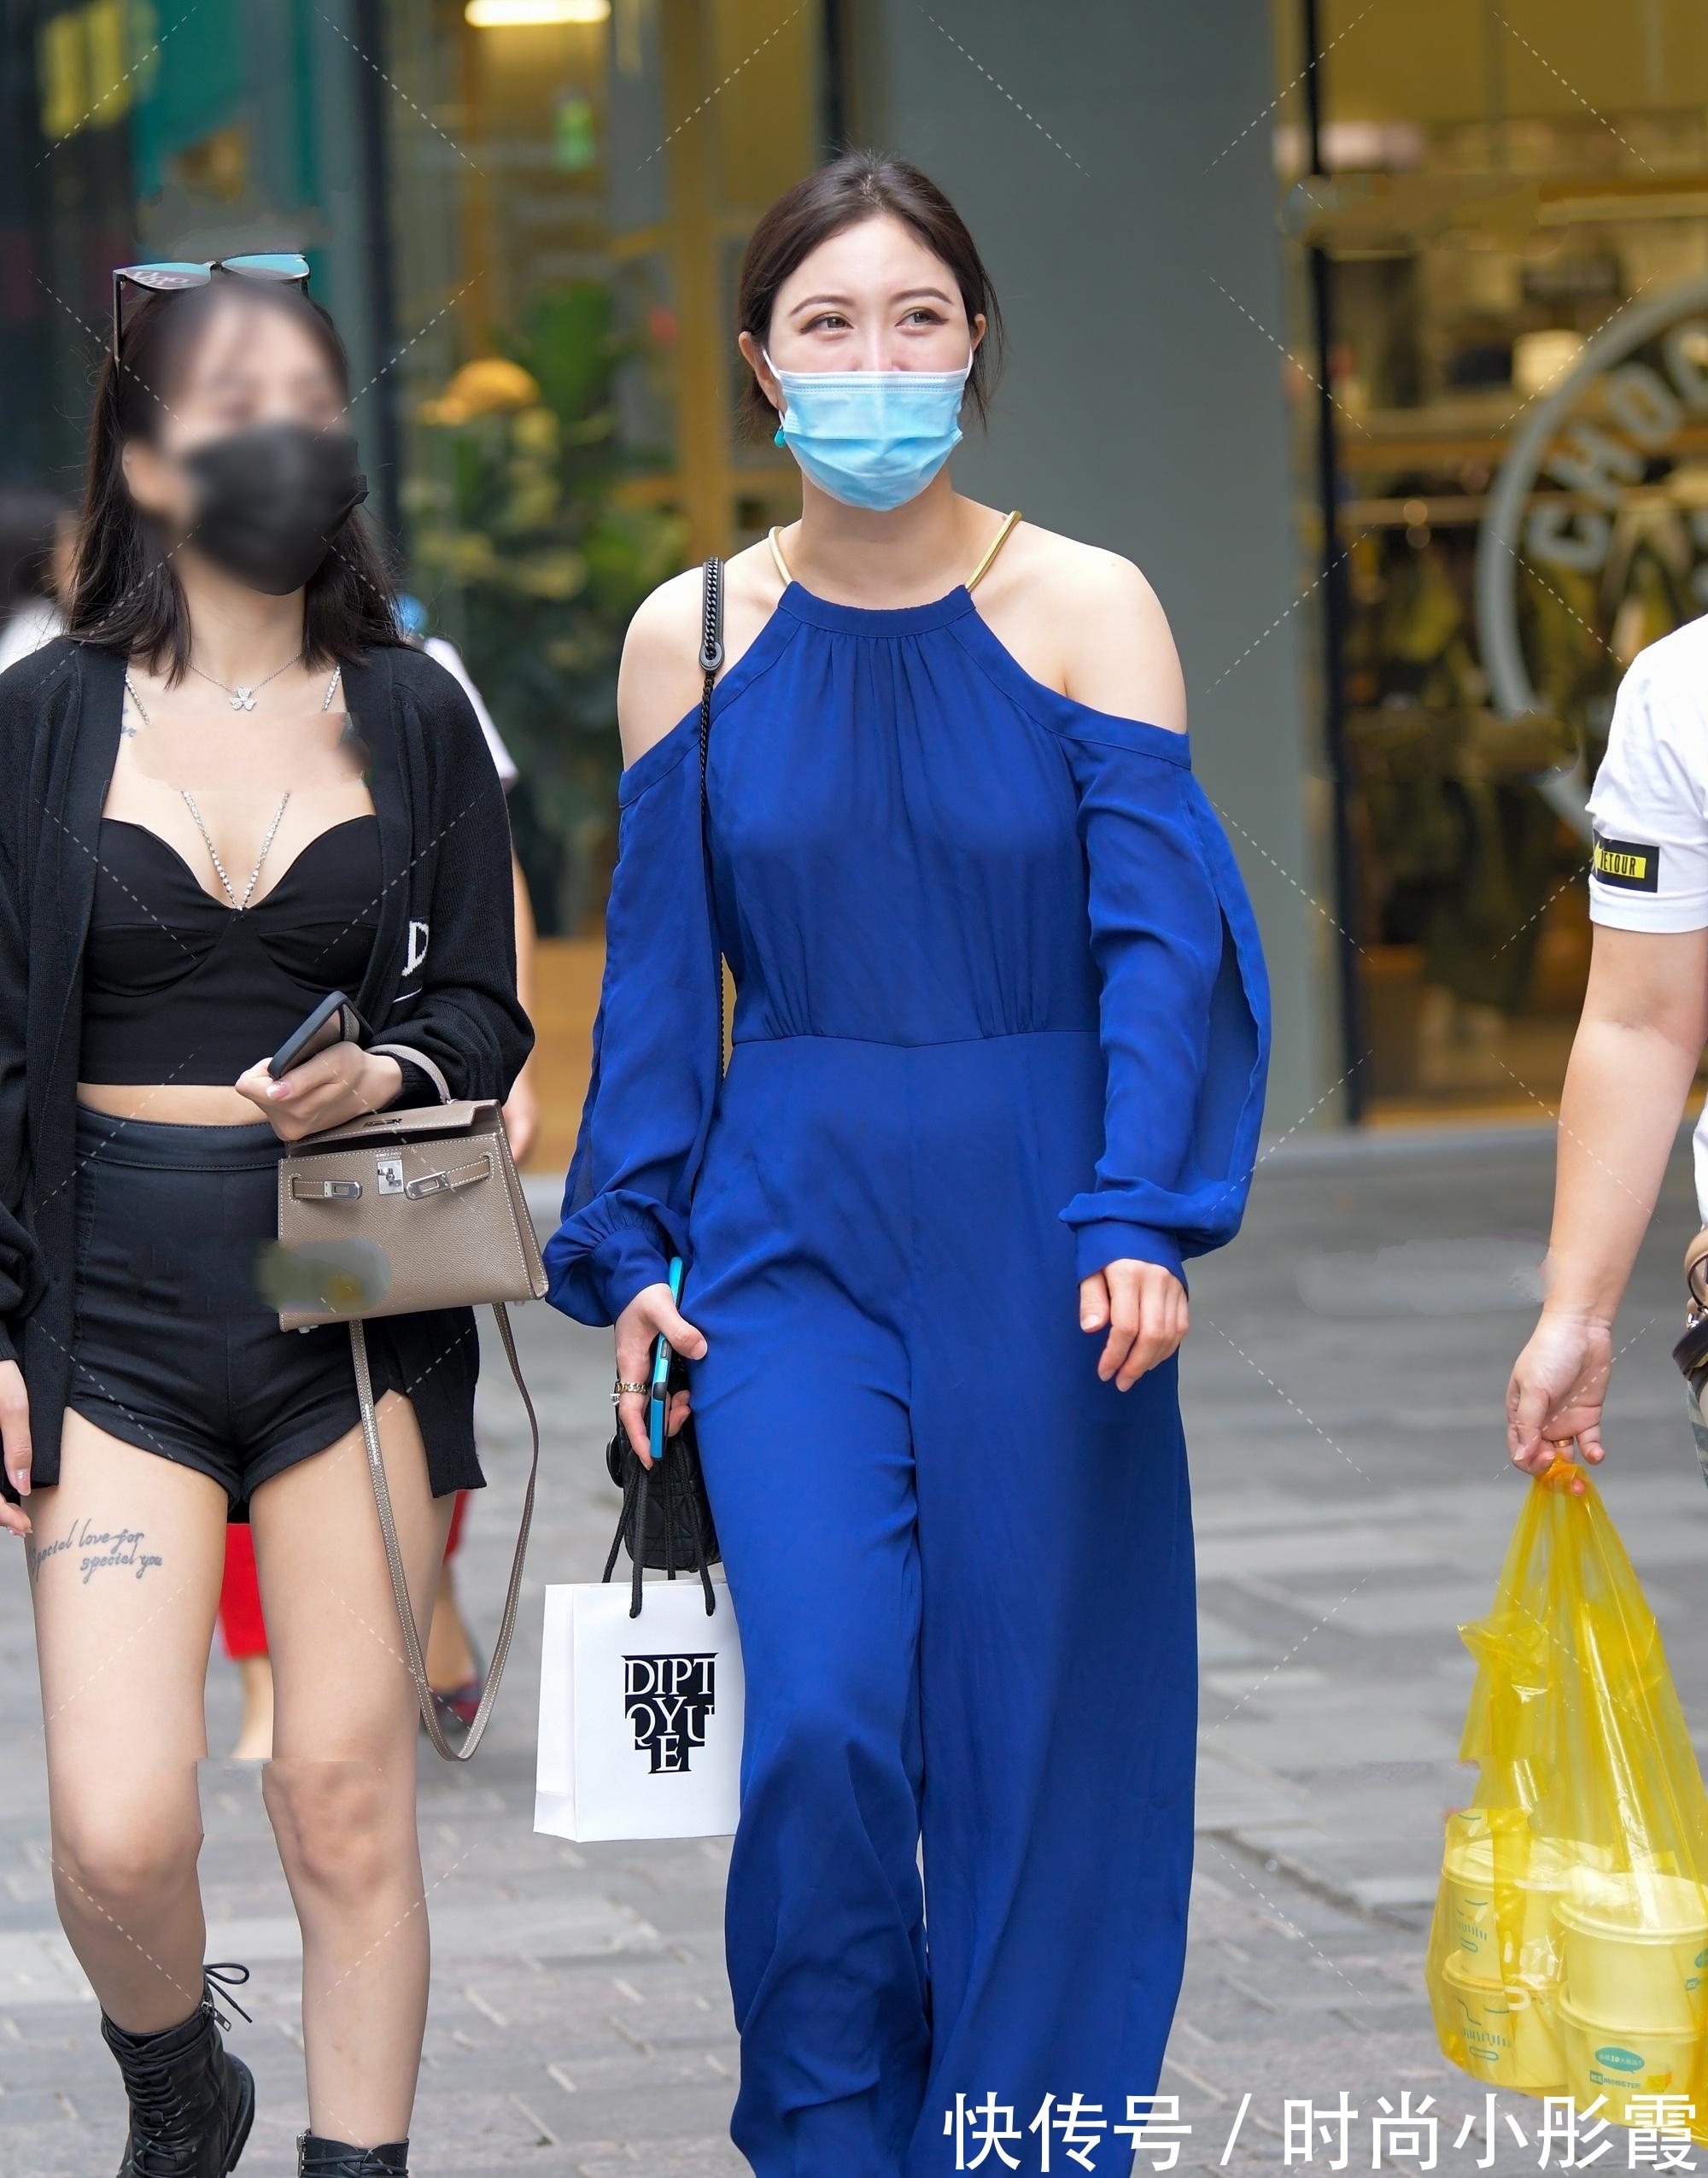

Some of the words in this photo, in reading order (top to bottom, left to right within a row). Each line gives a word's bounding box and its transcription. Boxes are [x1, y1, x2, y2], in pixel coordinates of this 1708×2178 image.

[79, 1519, 109, 1547] love
[110, 1529, 144, 1554] for
[80, 1543, 135, 1584] special
[136, 1554, 162, 1579] you
[624, 1658, 715, 1695] DIPT
